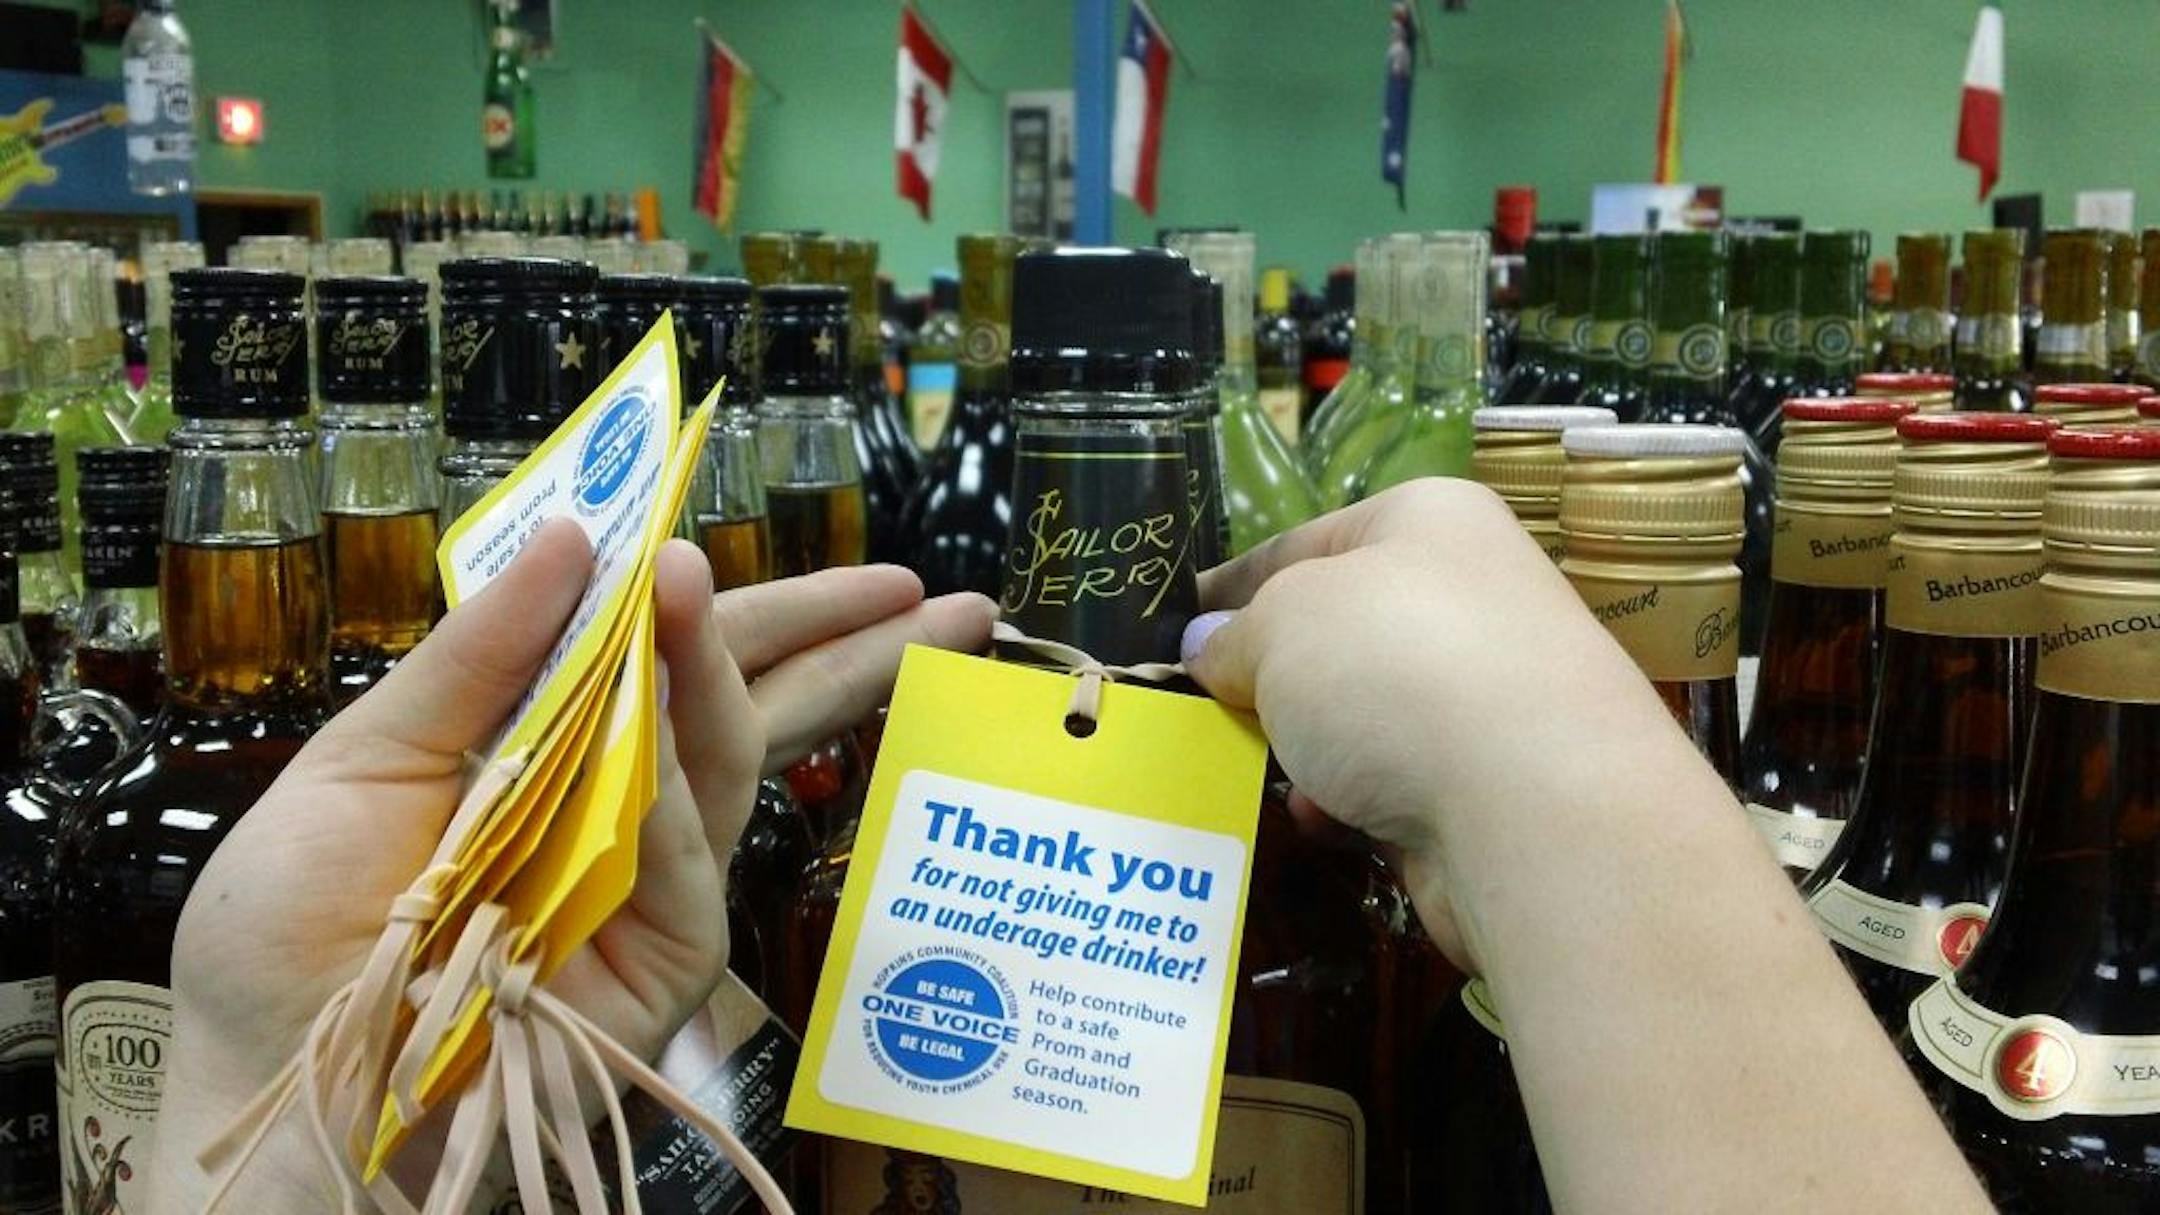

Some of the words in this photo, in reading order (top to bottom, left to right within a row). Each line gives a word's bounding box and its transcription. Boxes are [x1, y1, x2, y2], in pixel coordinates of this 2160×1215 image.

[234, 367, 278, 382] RUM
[345, 357, 384, 370] RUM
[466, 523, 517, 572] season
[1010, 489, 1175, 576] SAILOR
[925, 801, 1098, 877] Thank
[1107, 852, 1213, 901] you
[1779, 831, 1825, 850] AGED
[911, 857, 958, 890] for
[960, 878, 1015, 904] not
[1013, 884, 1112, 931] giving
[1115, 908, 1163, 936] me
[1166, 922, 1199, 944] to
[889, 897, 929, 923] an
[934, 904, 1078, 959] underage
[1081, 935, 1208, 985] drinker!
[1858, 915, 1906, 940] AGED
[916, 945, 988, 967] COMMUNITY
[916, 980, 937, 996] BE
[939, 985, 976, 1006] SAFE
[1029, 980, 1076, 1007] Help
[1081, 994, 1187, 1029] contribute
[862, 994, 924, 1022] ONE
[931, 1009, 1022, 1044] VOICE
[1036, 1009, 1057, 1026] to
[1061, 1016, 1073, 1030] a
[1078, 1019, 1120, 1041] safe
[105, 1033, 161, 1068] 100
[898, 1033, 919, 1050] BE
[920, 1038, 965, 1062] LEGAL
[1031, 1032, 1086, 1060] Prom
[1090, 1051, 1132, 1070] and
[1941, 1019, 1973, 1047] AGED
[2015, 1037, 2047, 1091] 4
[109, 1072, 155, 1089] YEARS
[942, 1069, 993, 1095] CHEMICAL
[1024, 1057, 1141, 1098] Graduation
[1012, 1085, 1089, 1114] season.
